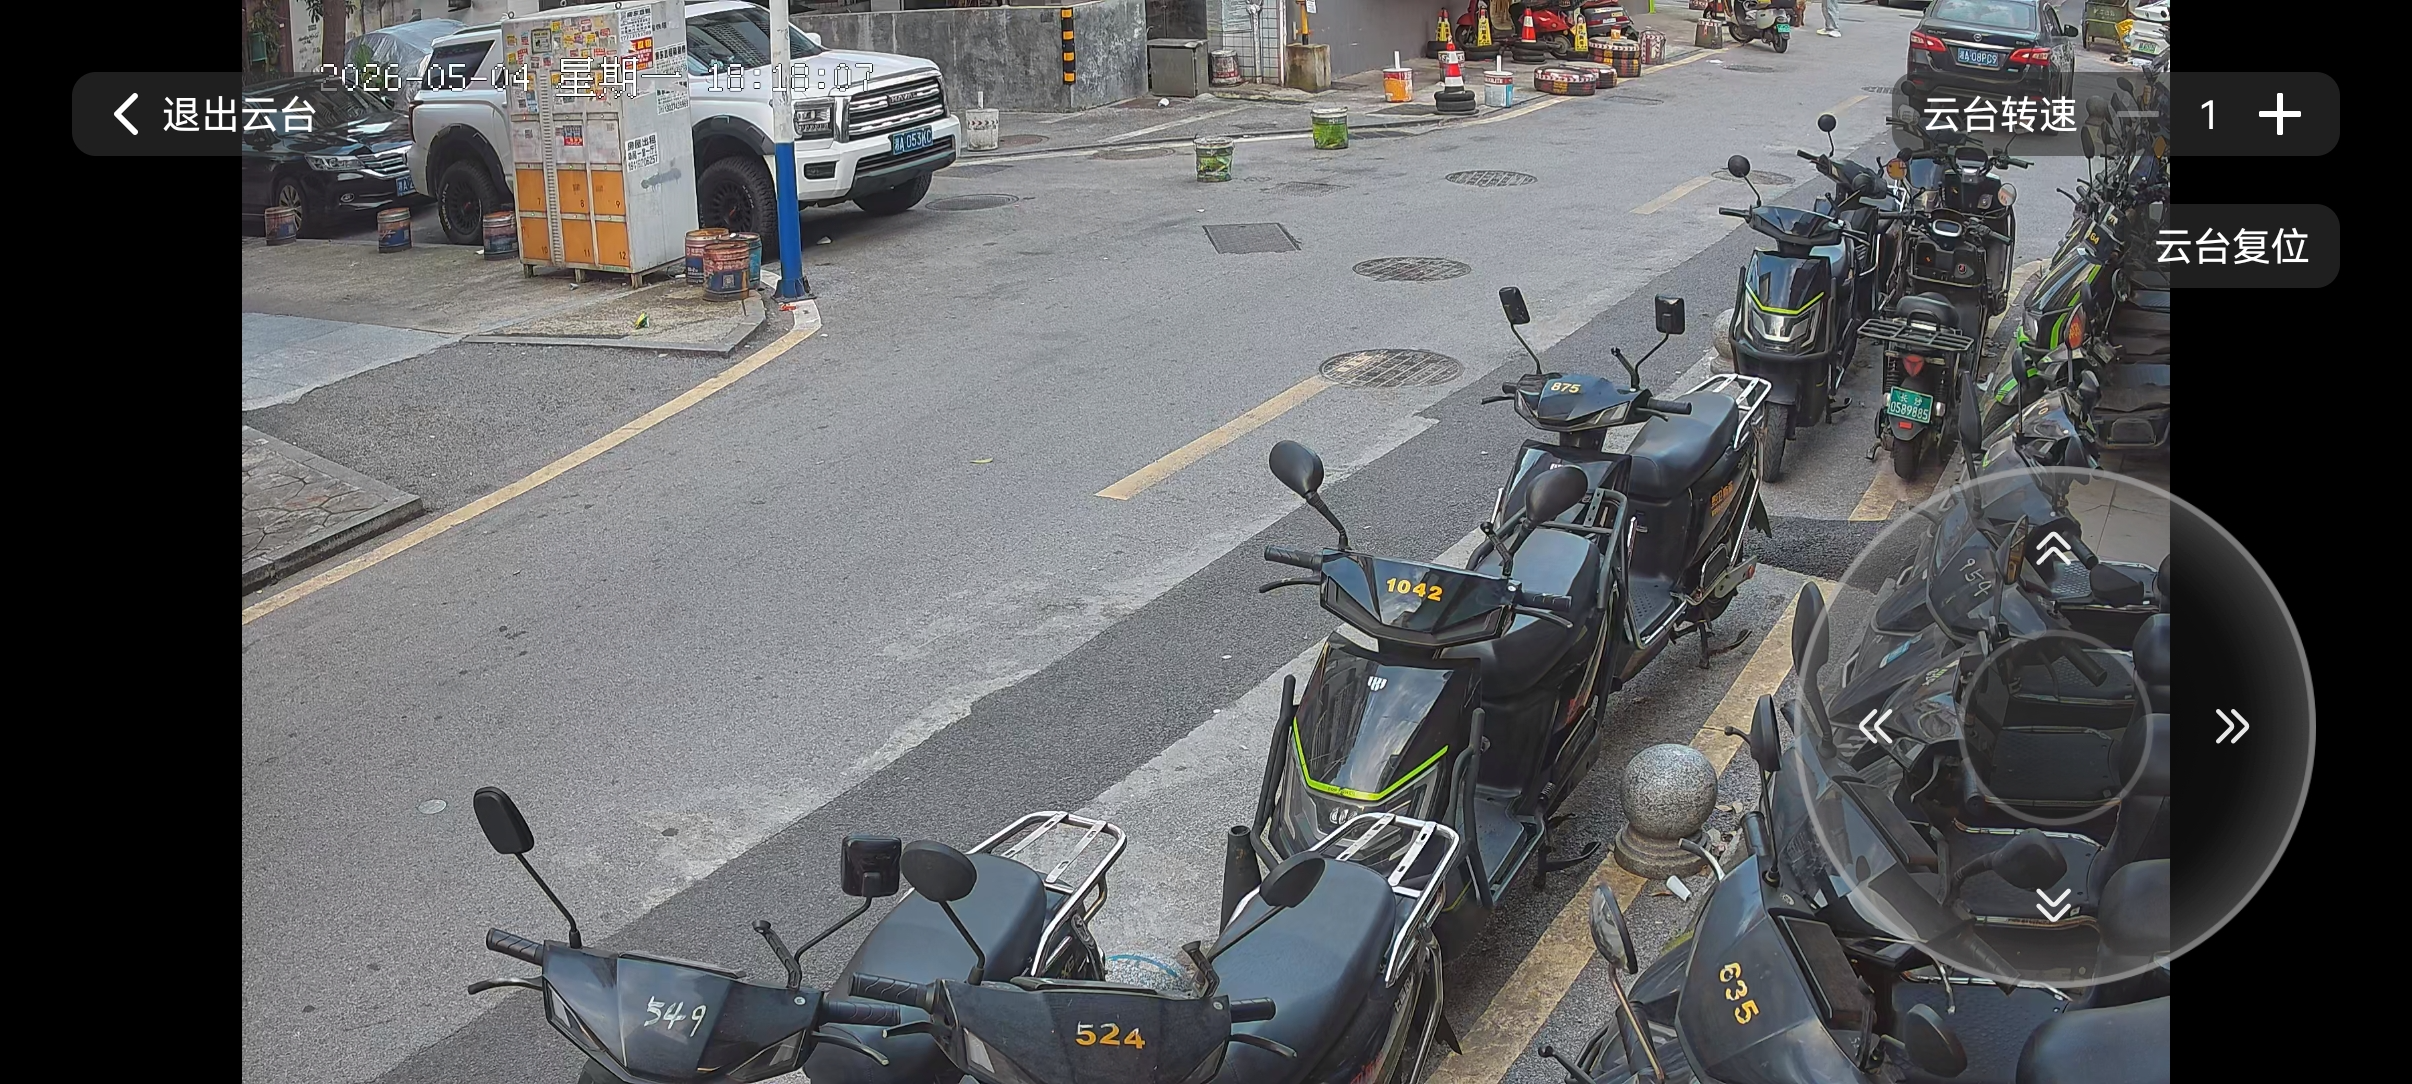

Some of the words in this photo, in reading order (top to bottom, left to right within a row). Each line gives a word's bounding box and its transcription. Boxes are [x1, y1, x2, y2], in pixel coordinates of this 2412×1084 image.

[891, 92, 918, 103] HAVAL
[616, 201, 621, 209] 9
[584, 249, 591, 257] 11
[619, 251, 626, 259] 12
[1550, 382, 1581, 394] 875
[1890, 401, 1929, 420] 0589885
[1386, 577, 1443, 602] 1042
[1719, 962, 1760, 1024] 635
[643, 995, 707, 1038] 549
[1075, 1020, 1146, 1050] 524
